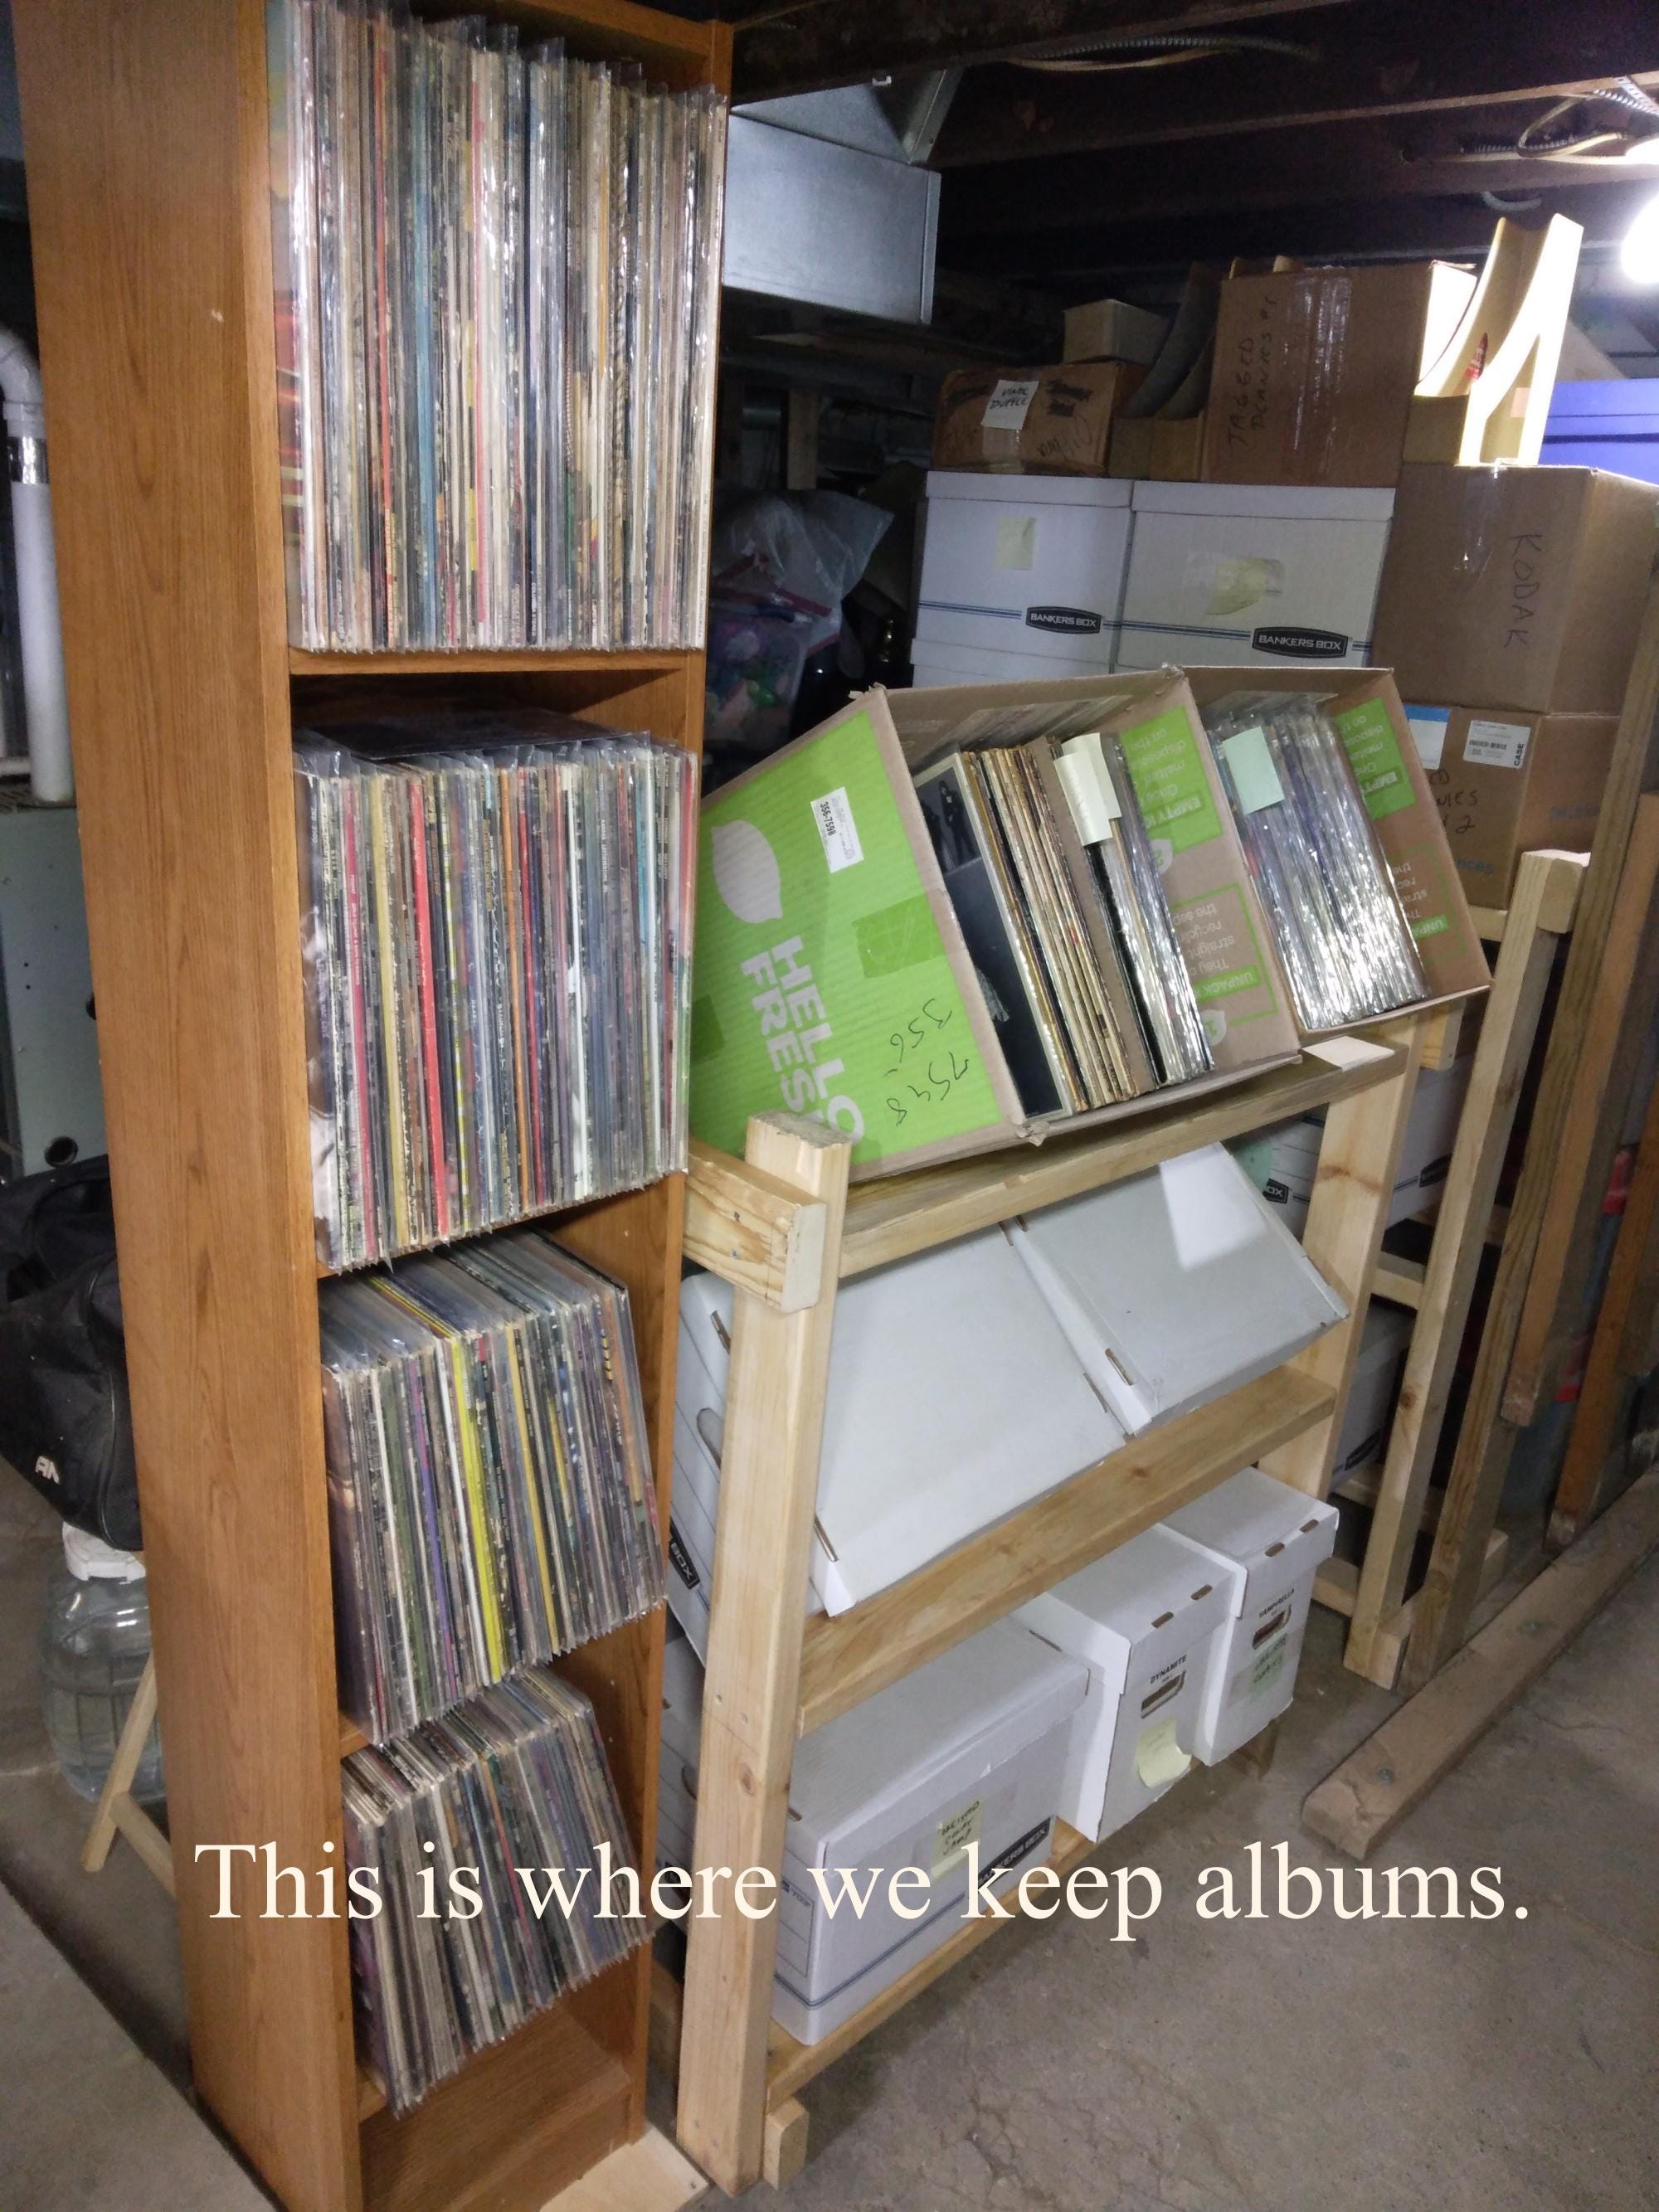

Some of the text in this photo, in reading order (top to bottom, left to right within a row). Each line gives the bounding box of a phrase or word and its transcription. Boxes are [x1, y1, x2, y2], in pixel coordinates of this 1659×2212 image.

[1504, 533, 1544, 649] KODAK
[1029, 611, 1097, 630] BANKERS BOX
[1258, 634, 1343, 652] BANKERS BOX
[1514, 743, 1525, 766] CASE
[1360, 771, 1398, 794] EMPT
[1158, 797, 1201, 821] EMPTY
[1437, 790, 1479, 807] NIES
[1404, 889, 1427, 904] stra
[1195, 902, 1218, 919] the
[1198, 958, 1228, 975] They
[769, 935, 865, 1141] HELLO
[1267, 1186, 1282, 1197] OX
[671, 1543, 693, 1579] BOX
[1150, 1655, 1187, 1684] DYNAMITE
